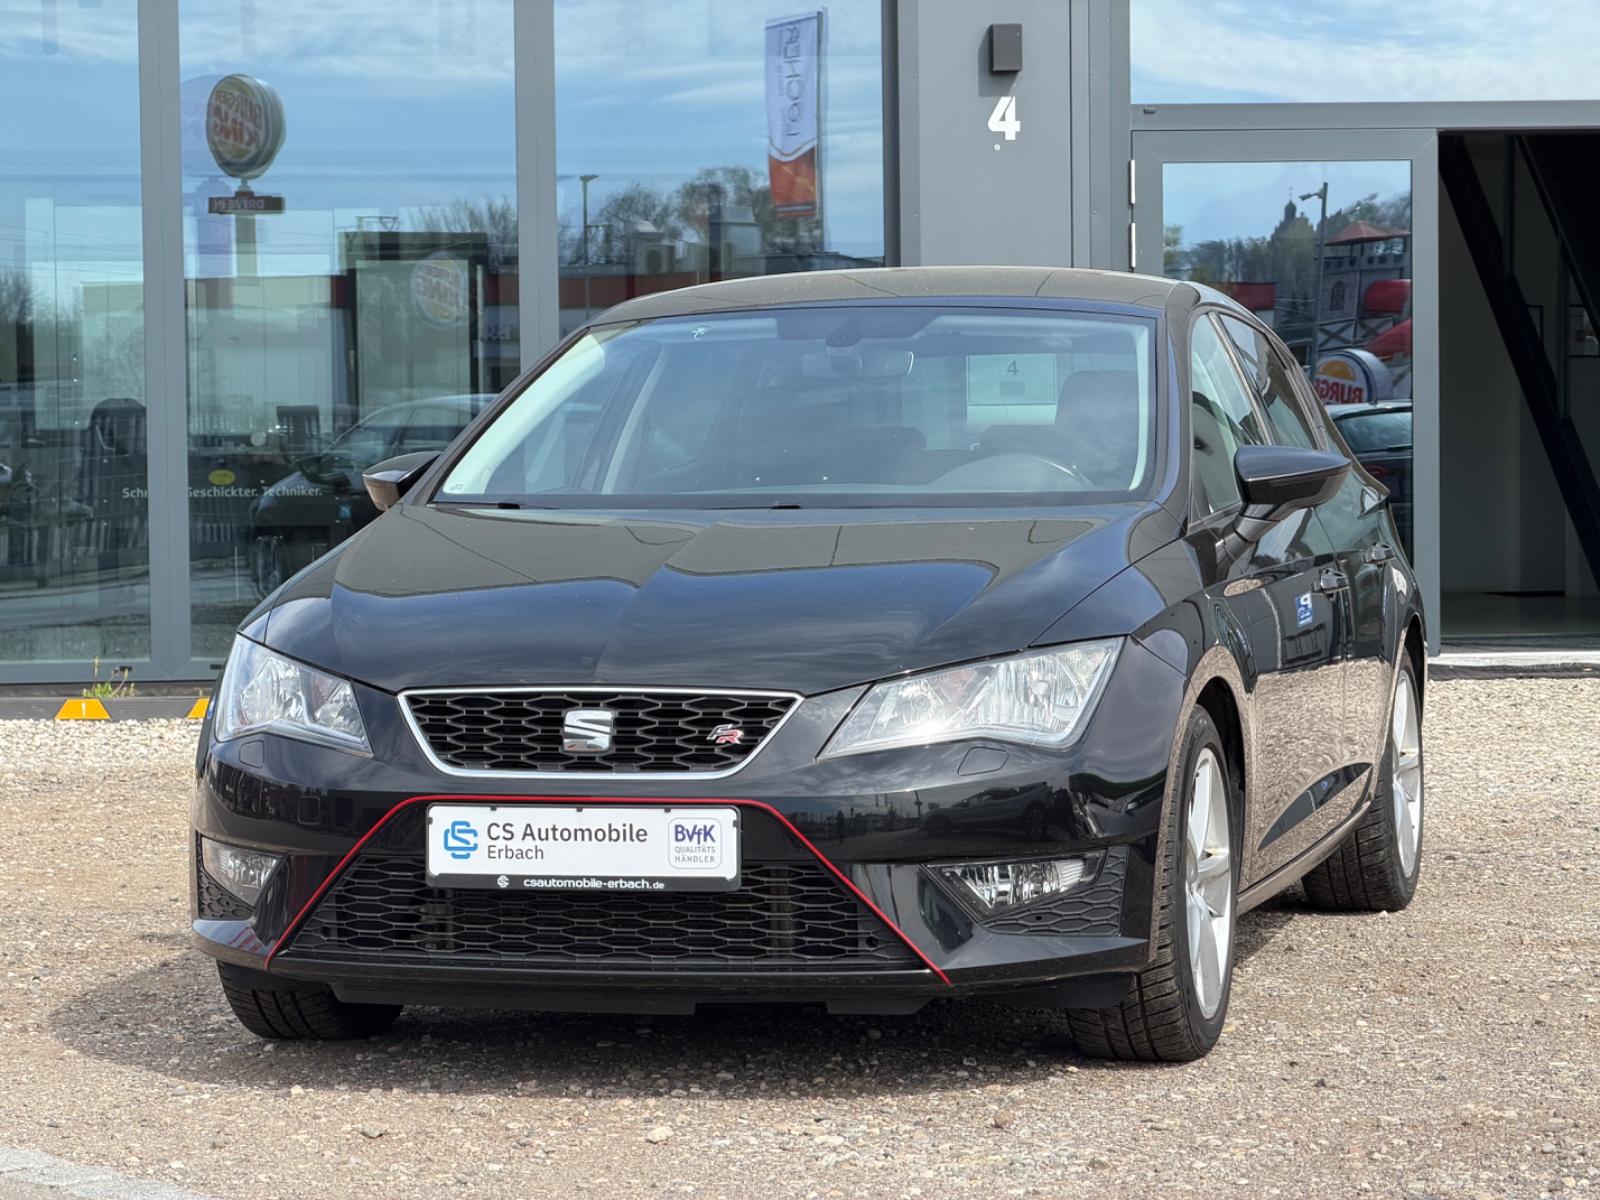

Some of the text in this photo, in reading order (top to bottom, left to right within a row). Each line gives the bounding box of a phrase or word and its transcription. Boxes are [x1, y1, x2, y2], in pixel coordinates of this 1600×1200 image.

[988, 96, 1021, 141] 4
[262, 485, 323, 498] Techniker.
[706, 724, 744, 744] FR
[487, 823, 648, 842] CS Automobile
[487, 845, 544, 860] Erbach
[674, 846, 716, 854] QUALITÄTS
[674, 855, 716, 863] HÄNDLER
[523, 877, 665, 889] csautomobile-erbach.de
